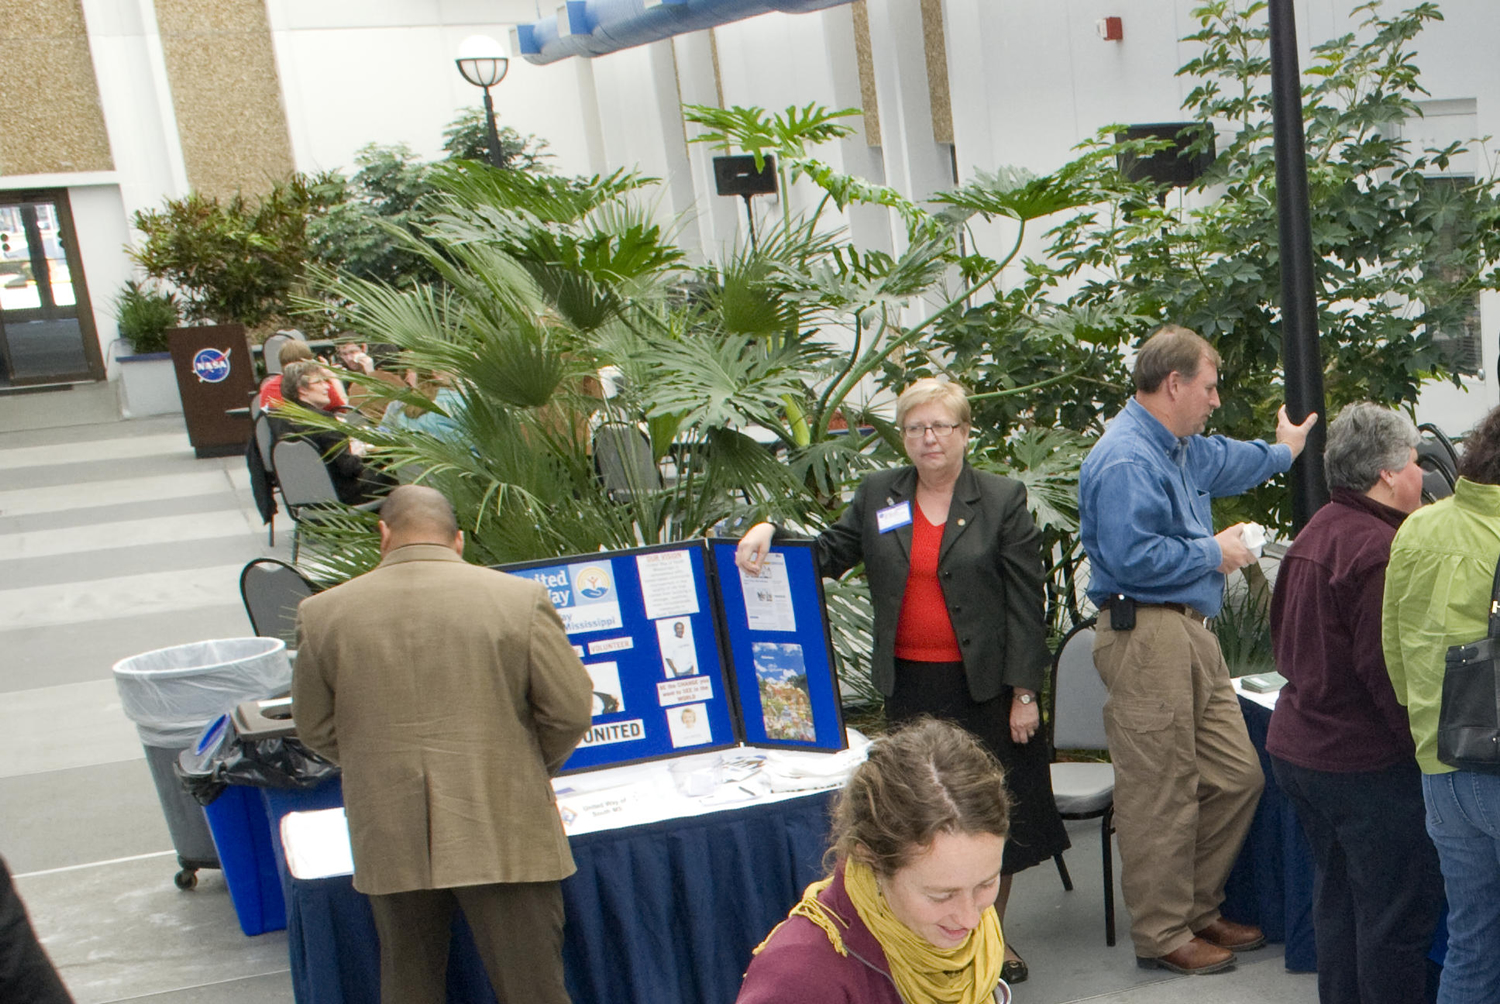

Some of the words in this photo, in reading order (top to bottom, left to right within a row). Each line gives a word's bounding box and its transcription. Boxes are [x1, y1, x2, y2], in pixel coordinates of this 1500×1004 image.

[196, 361, 227, 370] NASA
[534, 570, 569, 588] ited
[565, 616, 616, 631] Mississippi
[591, 640, 630, 652] VOLUNTEER
[583, 723, 641, 743] UNITED
